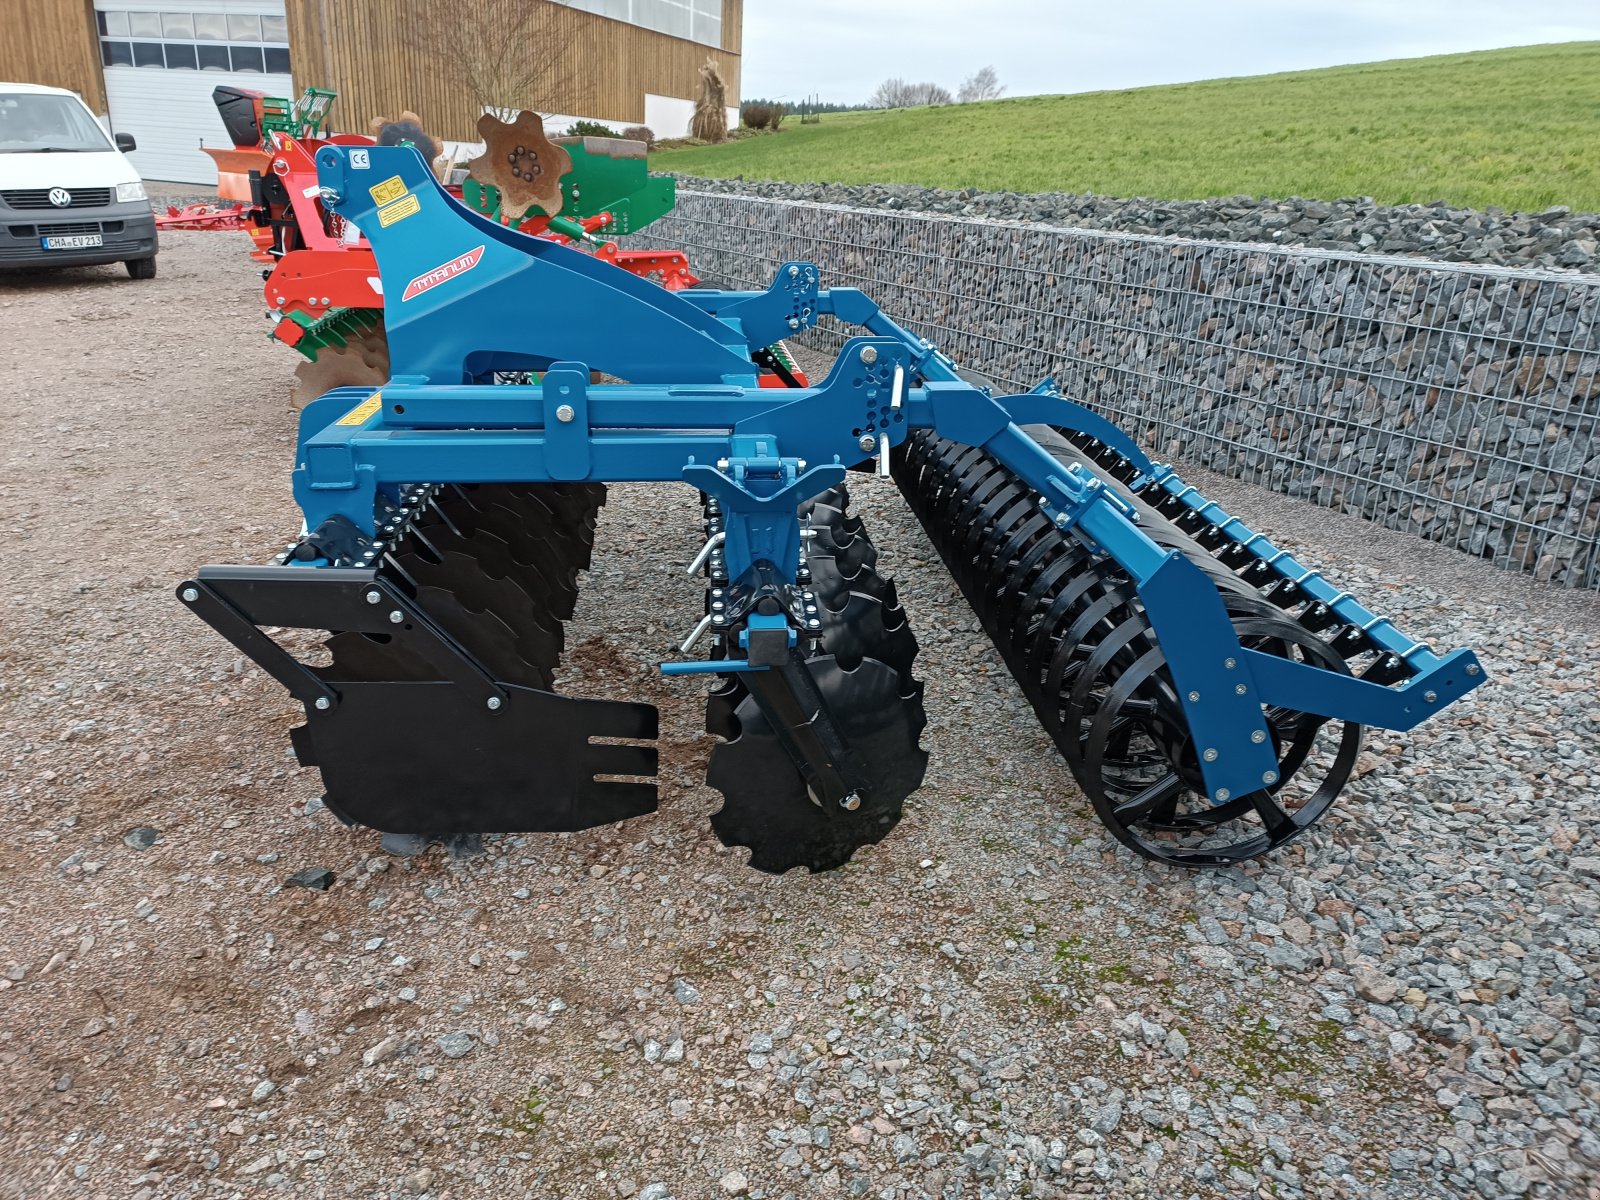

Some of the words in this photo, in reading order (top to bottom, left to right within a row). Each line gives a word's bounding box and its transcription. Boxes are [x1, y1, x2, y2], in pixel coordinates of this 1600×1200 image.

[352, 153, 367, 164] CE
[48, 238, 67, 248] CHA
[72, 237, 84, 246] EV
[85, 236, 102, 246] 213
